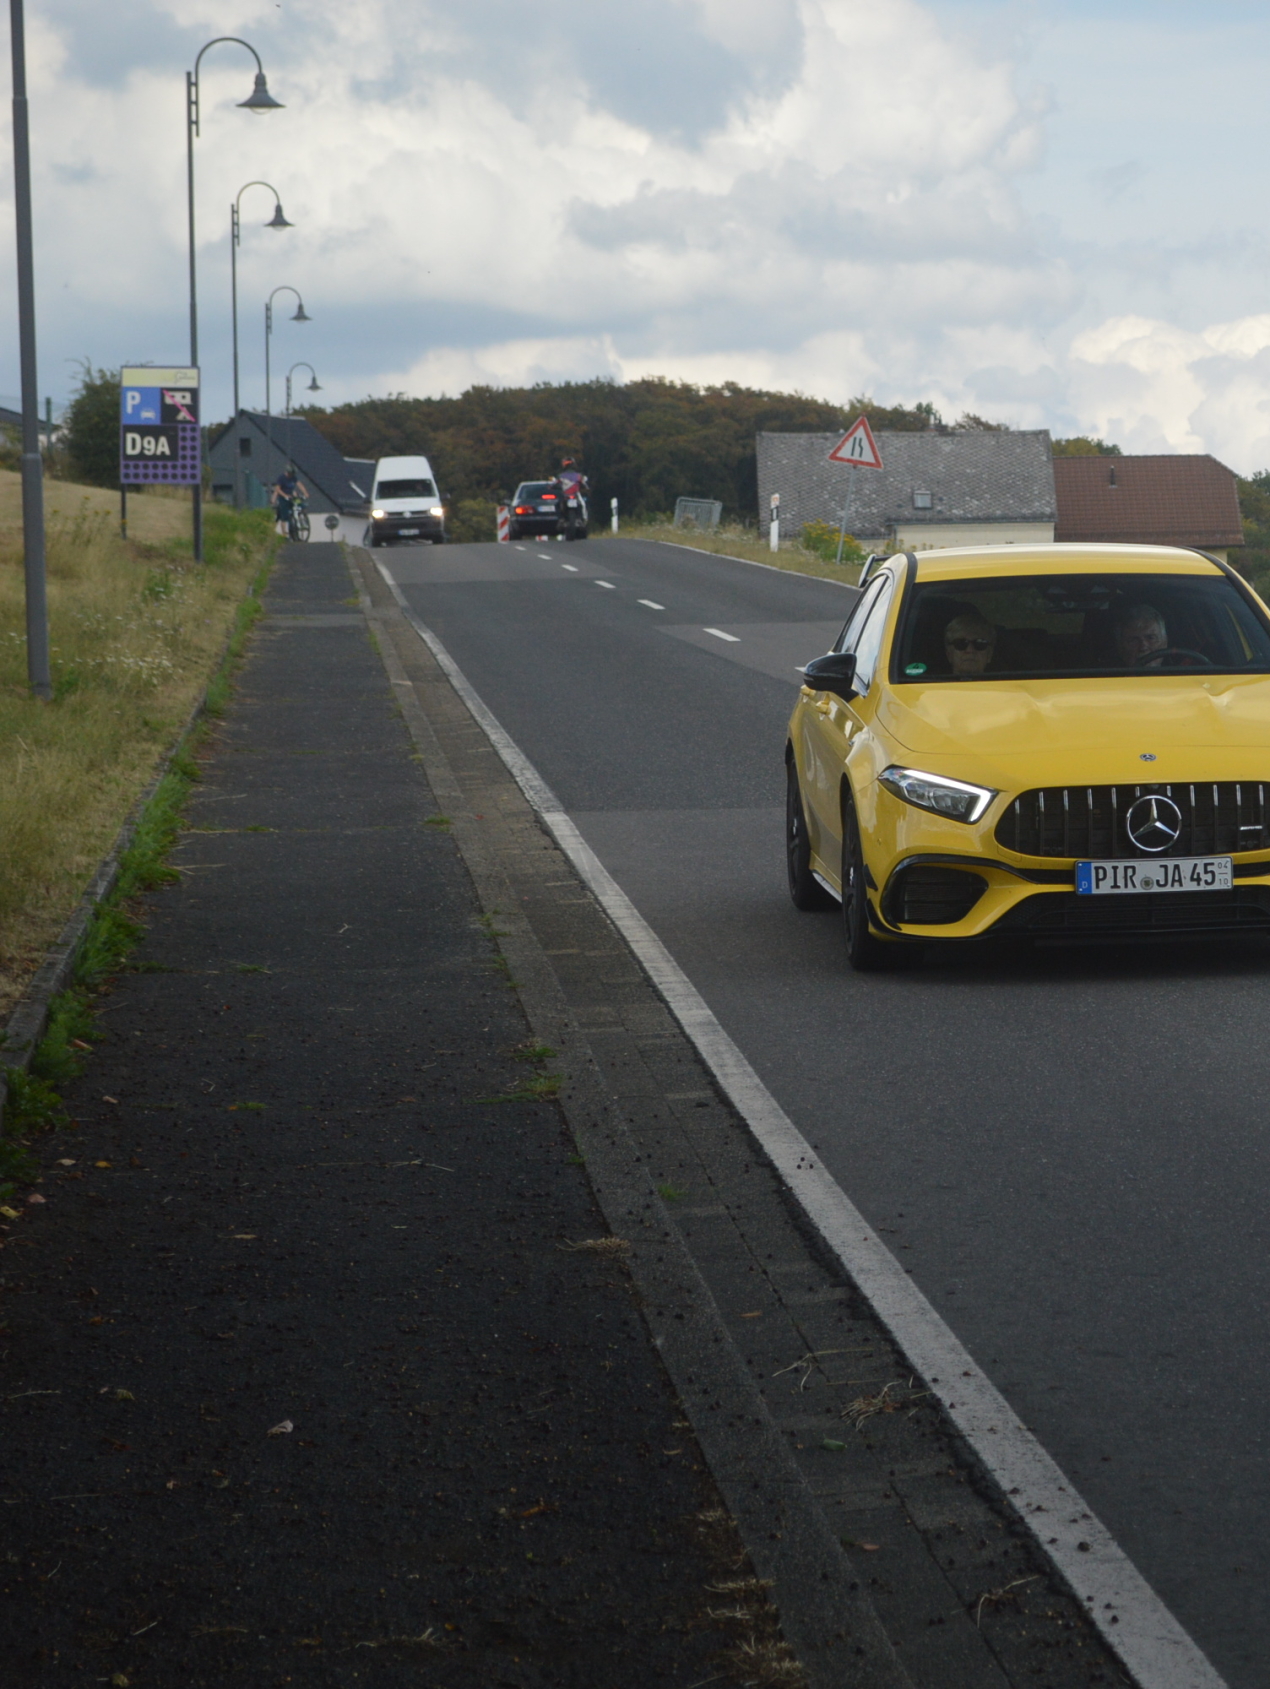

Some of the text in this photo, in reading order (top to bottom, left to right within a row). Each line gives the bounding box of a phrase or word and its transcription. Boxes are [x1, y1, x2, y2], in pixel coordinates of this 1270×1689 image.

[126, 391, 141, 414] P
[125, 432, 171, 456] D9A
[1081, 881, 1088, 889] D
[1093, 862, 1216, 890] PIR JA 45
